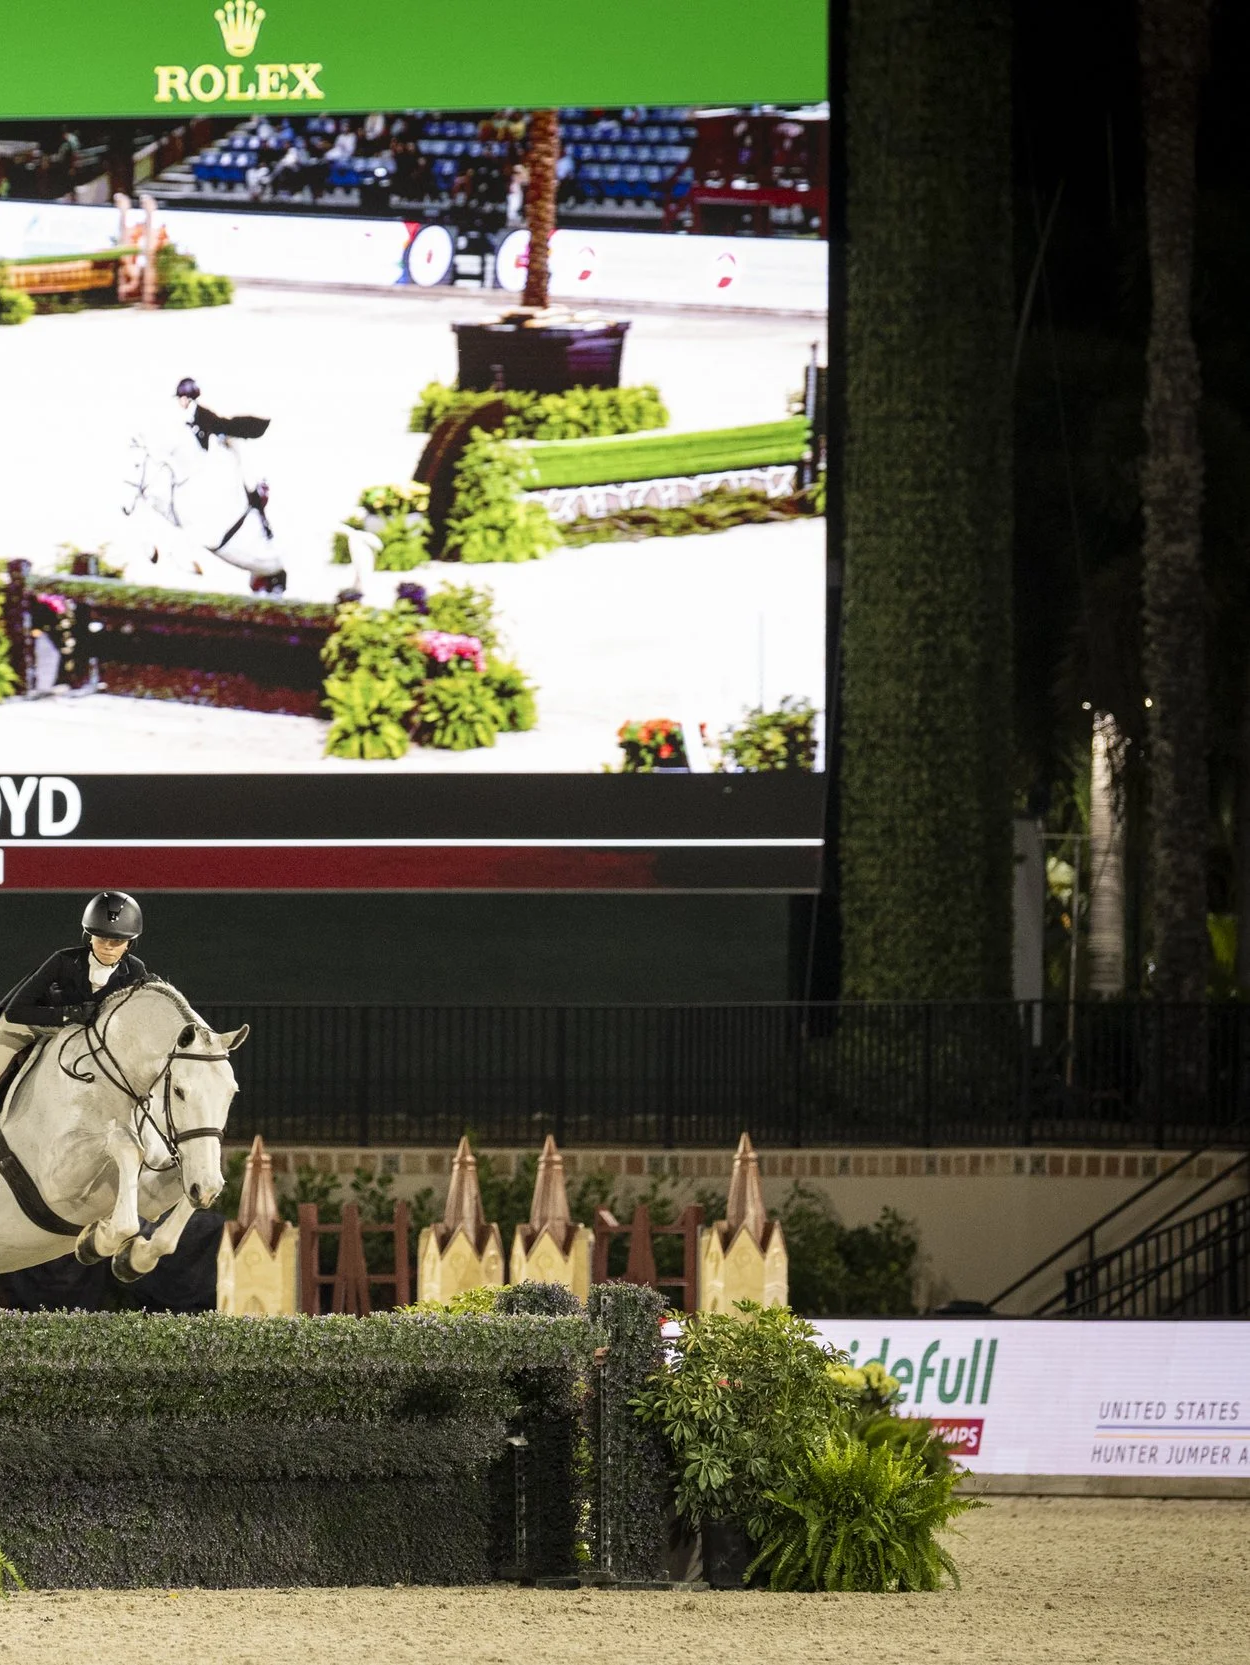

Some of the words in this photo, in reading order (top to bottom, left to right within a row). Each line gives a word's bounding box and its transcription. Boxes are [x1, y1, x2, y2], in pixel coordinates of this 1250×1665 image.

[154, 62, 325, 103] ROLEX
[1099, 1401, 1167, 1420] UNITED
[1174, 1401, 1241, 1420] STATES
[1091, 1444, 1159, 1463] HUNTER
[1166, 1445, 1231, 1464] JUMPER
